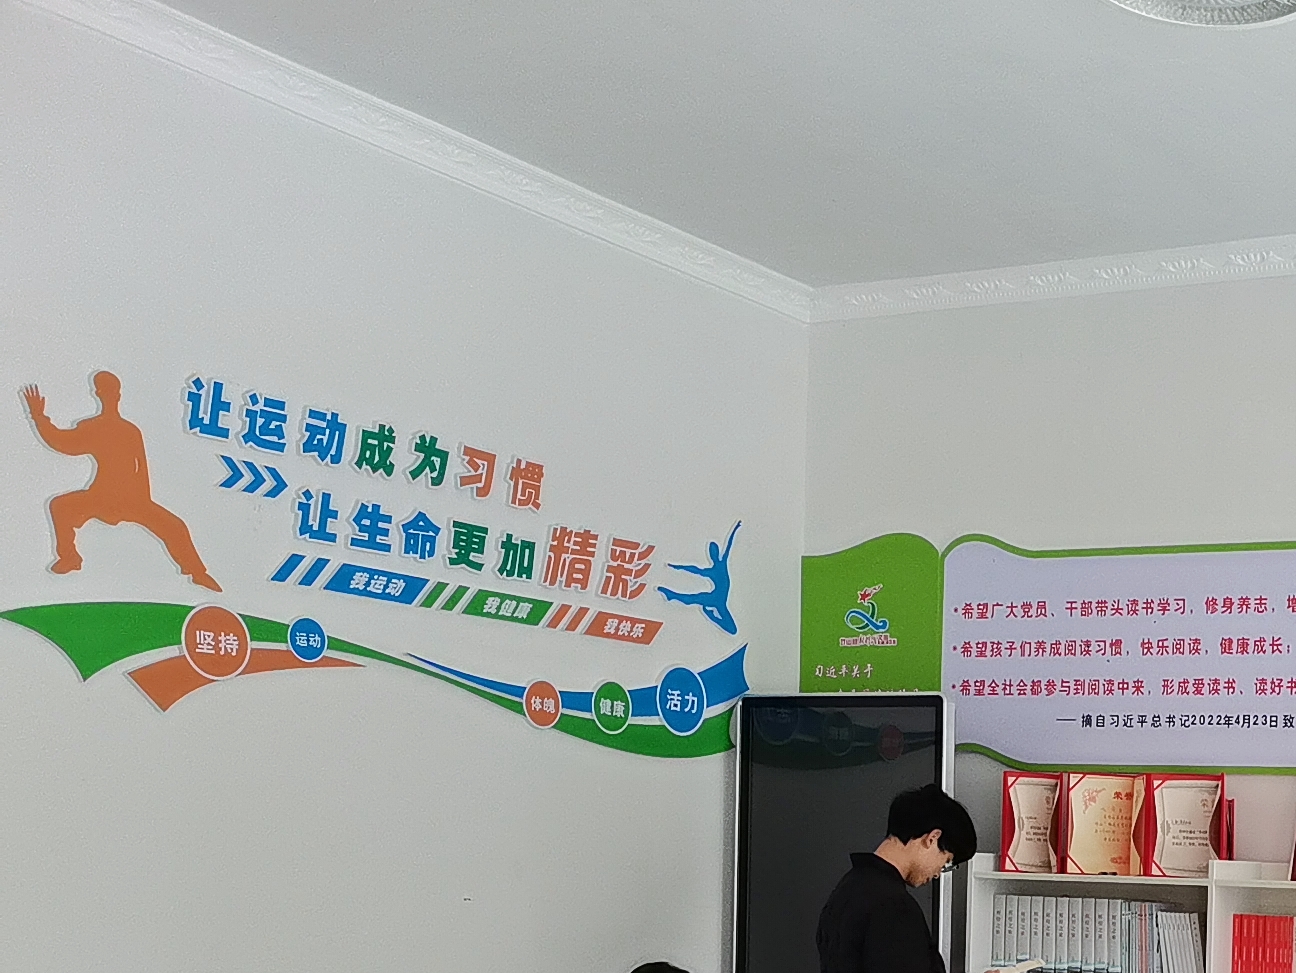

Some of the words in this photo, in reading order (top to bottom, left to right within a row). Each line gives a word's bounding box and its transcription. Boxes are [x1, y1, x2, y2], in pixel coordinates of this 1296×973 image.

[186, 376, 546, 511] 让运动成为习惯
[296, 491, 656, 601] 让生命更加精彩
[350, 570, 406, 597] 我运动
[482, 596, 531, 620] 我健康
[603, 617, 646, 640] 我快乐
[196, 631, 240, 657] 坚持
[295, 631, 321, 651] 运动
[530, 695, 556, 716] 体魄
[599, 697, 626, 719] 健康
[666, 688, 699, 713] 活力
